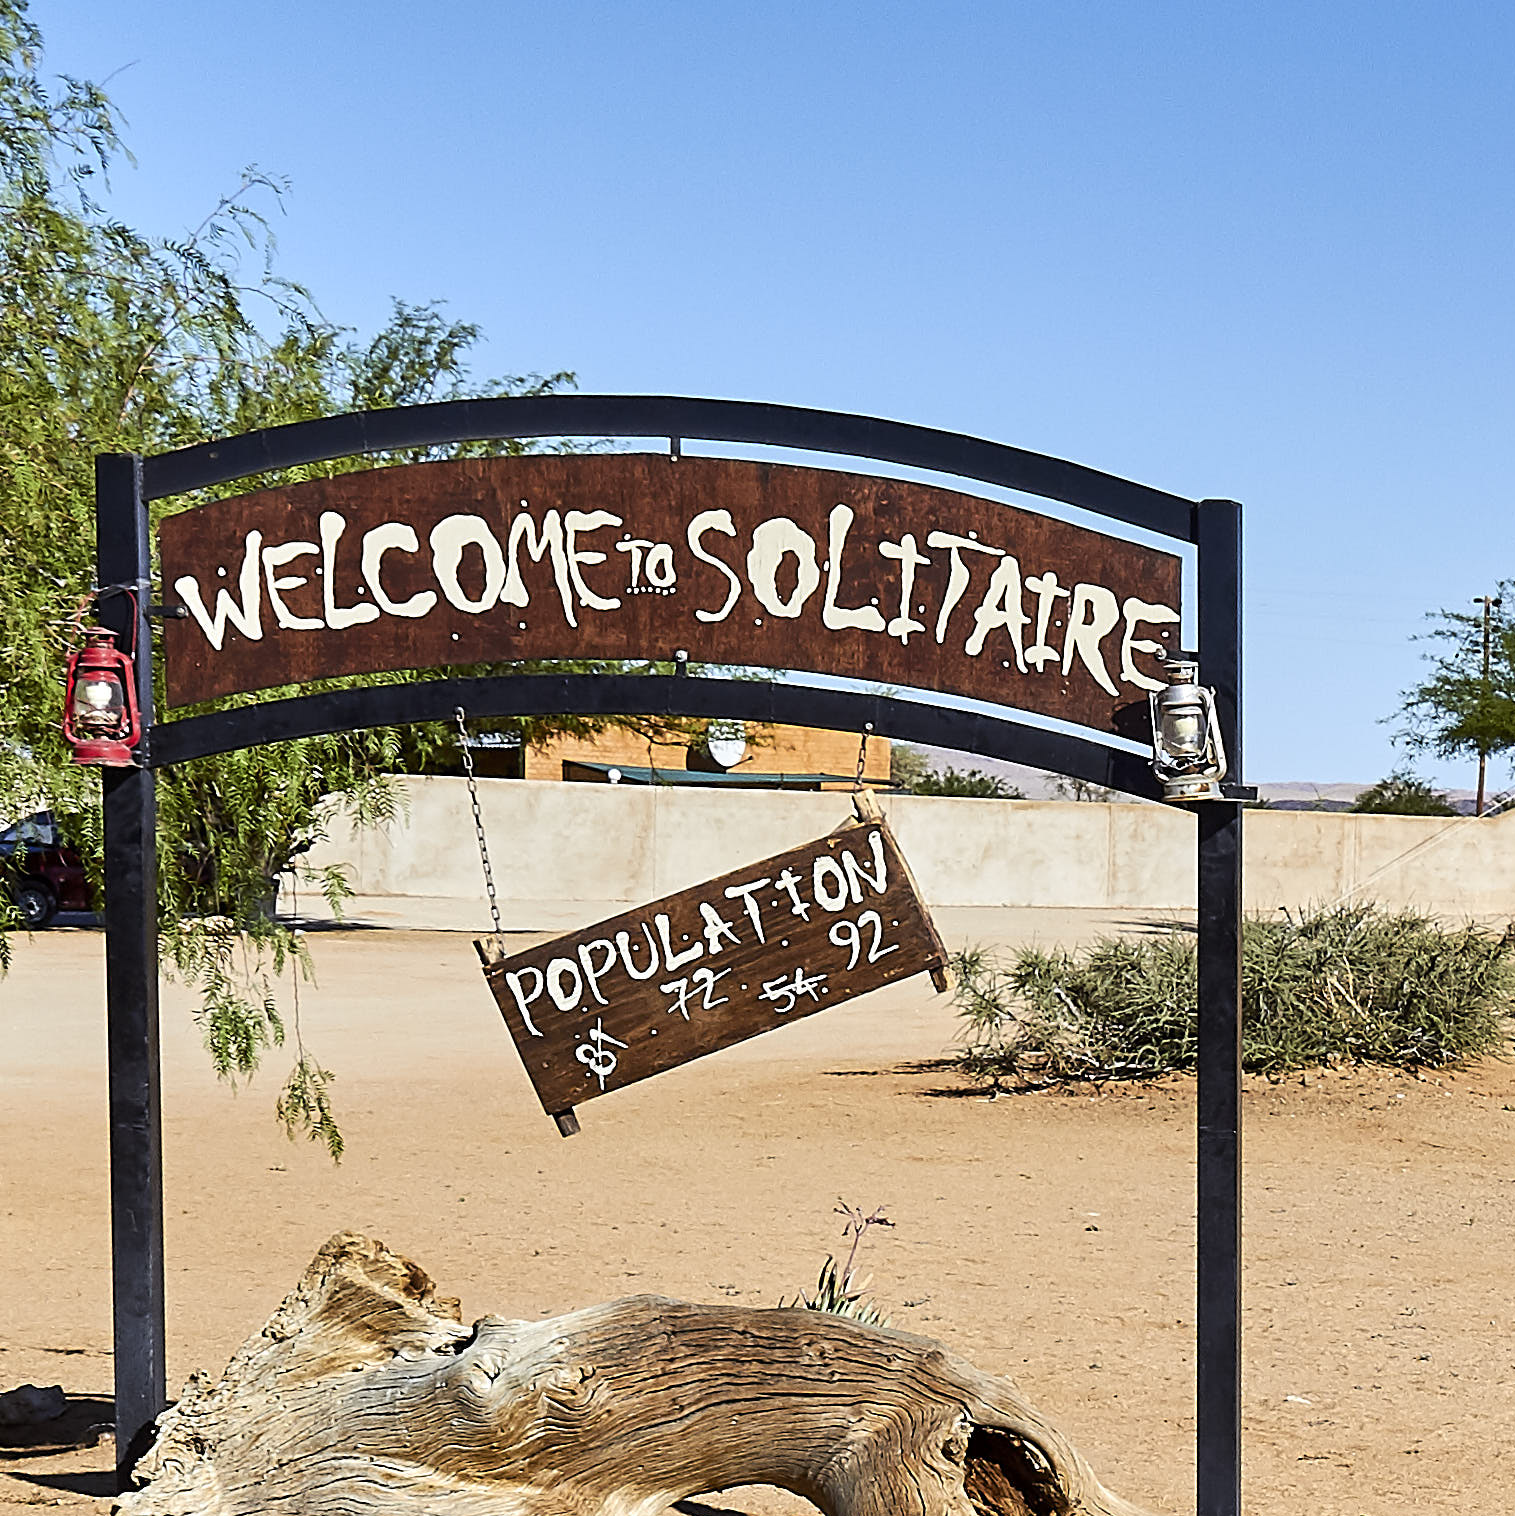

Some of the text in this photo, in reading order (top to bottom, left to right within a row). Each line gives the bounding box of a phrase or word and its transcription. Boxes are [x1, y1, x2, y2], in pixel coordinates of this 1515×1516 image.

[174, 503, 1182, 698] WELCOME TO SOLITAIRE
[505, 829, 889, 1038] POPULATION
[660, 966, 731, 1021] 72
[759, 967, 828, 1015] 54
[828, 909, 900, 972] 92
